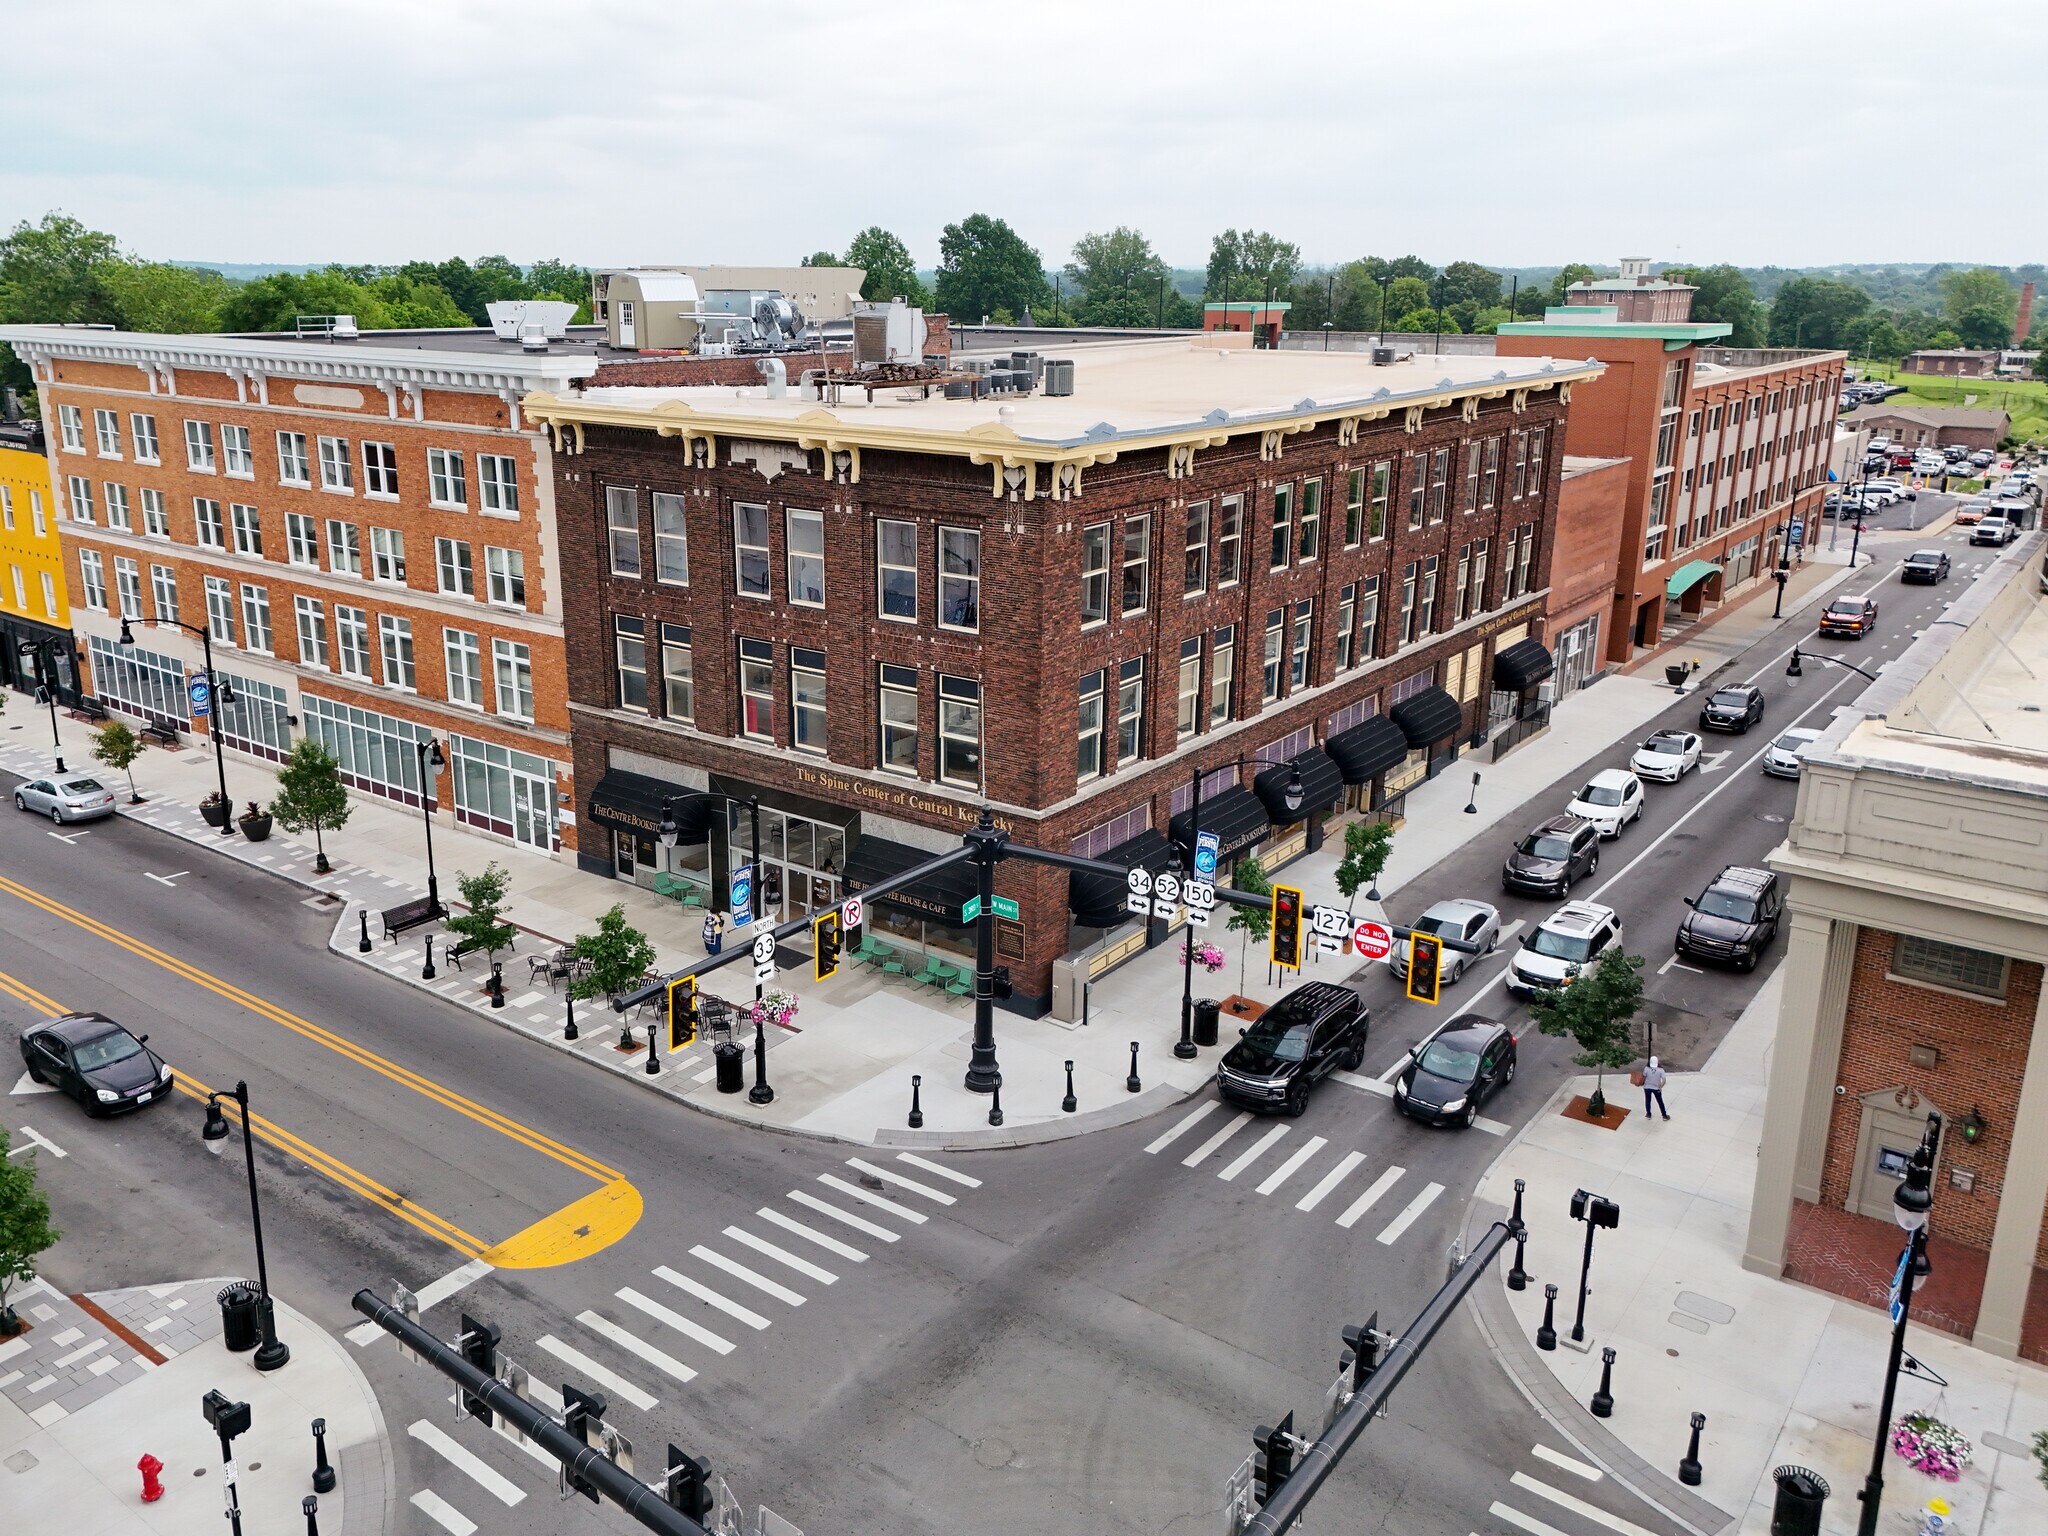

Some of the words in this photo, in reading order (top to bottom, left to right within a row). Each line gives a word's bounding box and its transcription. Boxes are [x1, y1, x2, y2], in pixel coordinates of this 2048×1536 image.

[795, 768, 817, 783] The
[820, 773, 850, 790] Spine
[853, 782, 890, 801] Center
[893, 793, 905, 805] of
[909, 795, 953, 817] Central
[631, 814, 660, 833] BOOKSTO
[1129, 872, 1150, 891] 34
[1157, 879, 1177, 897] 52
[849, 879, 861, 890] THE
[899, 893, 921, 908] HOUSE
[921, 901, 928, 910] &
[928, 903, 947, 915] CAFE
[1185, 884, 1213, 904] 150
[991, 900, 998, 908] W
[998, 902, 1013, 913] MAIN
[754, 918, 774, 934] NORTH
[1316, 911, 1347, 932] 127
[1360, 927, 1370, 935] DO
[1372, 930, 1386, 939] NOT
[756, 938, 774, 958] 33
[1361, 944, 1382, 954] ENTER
